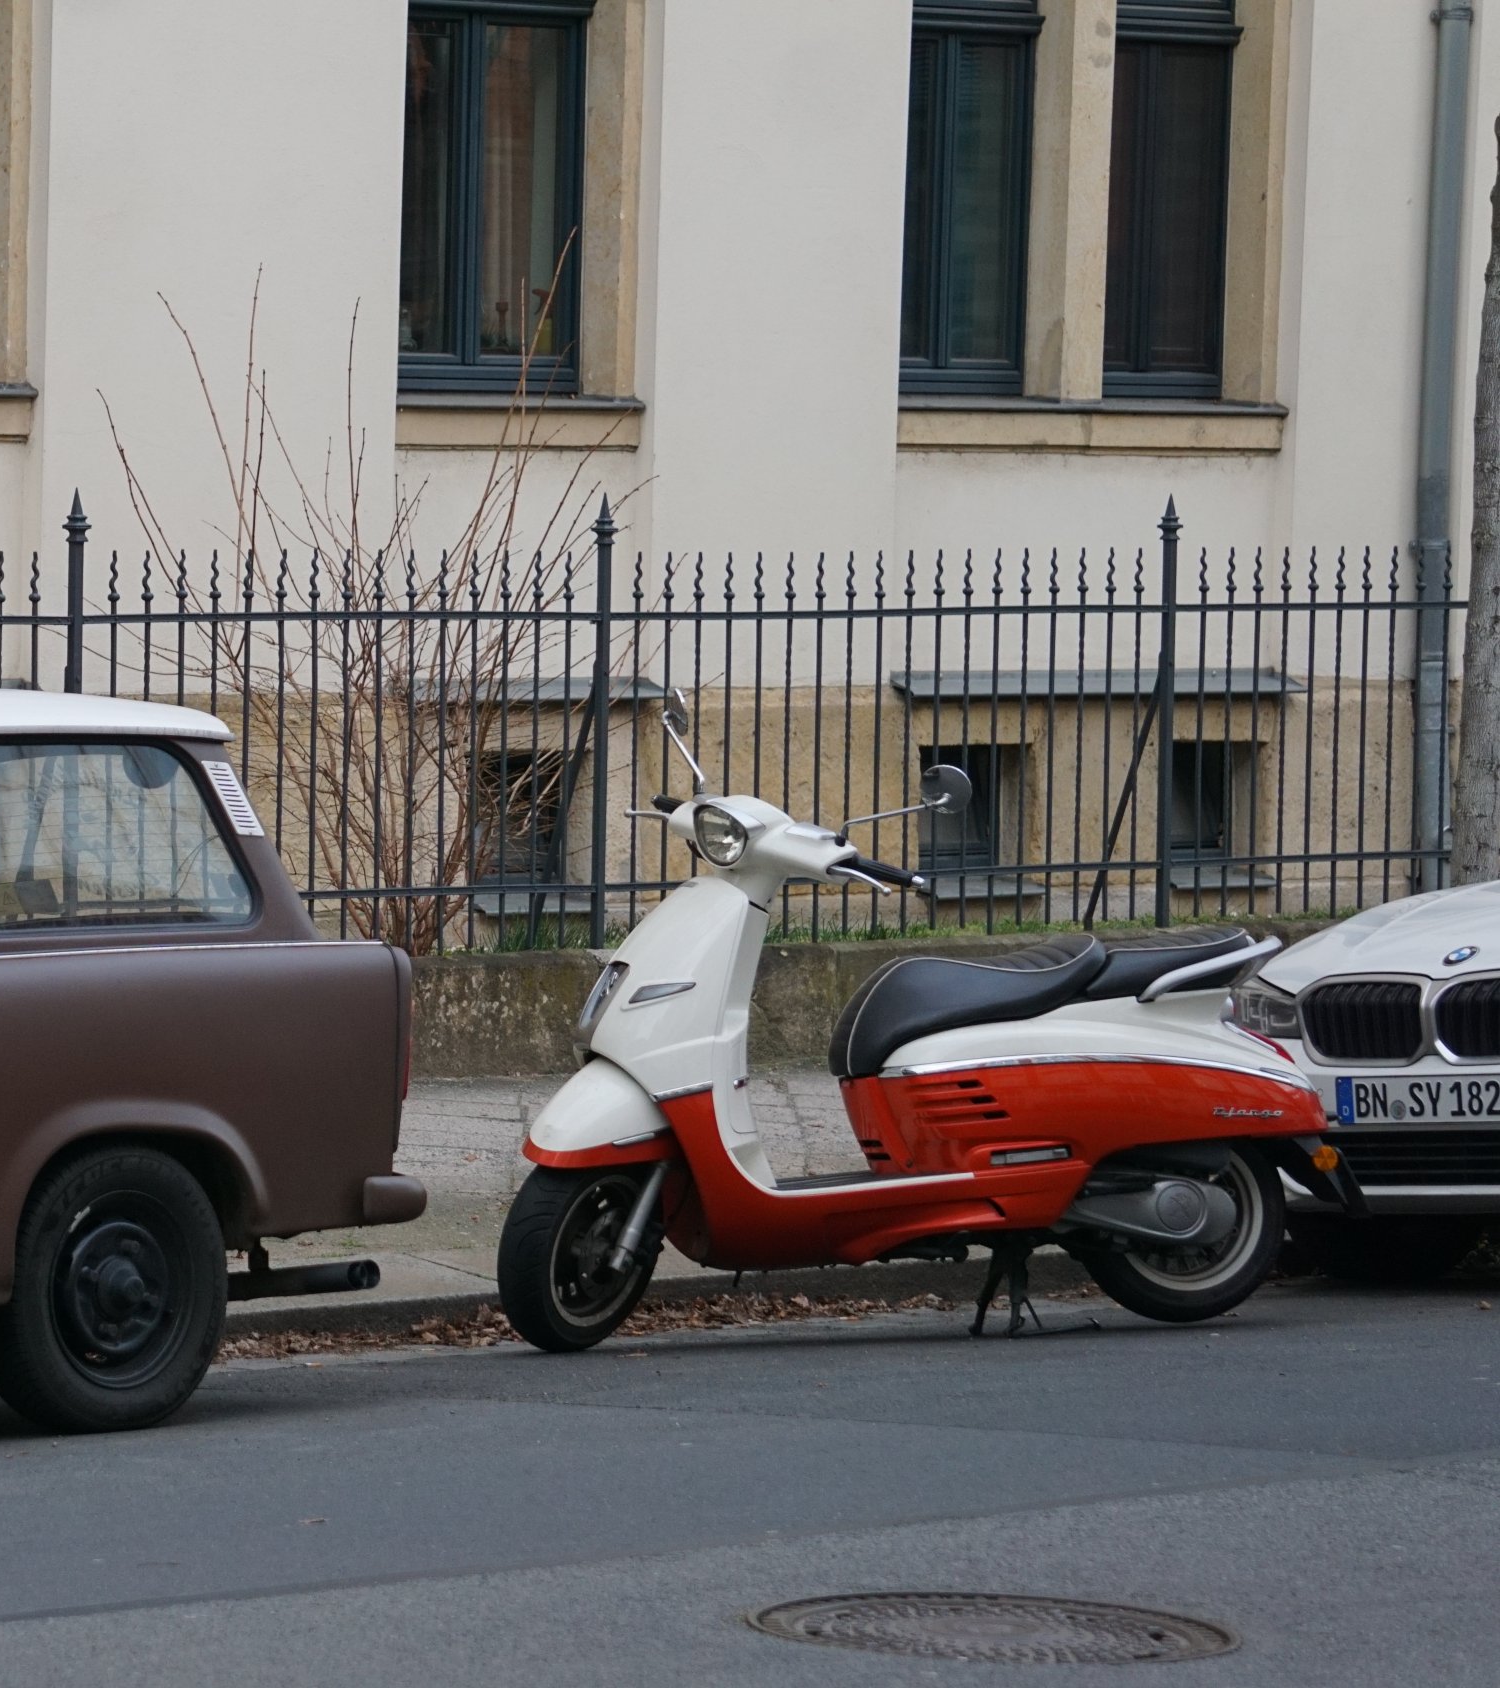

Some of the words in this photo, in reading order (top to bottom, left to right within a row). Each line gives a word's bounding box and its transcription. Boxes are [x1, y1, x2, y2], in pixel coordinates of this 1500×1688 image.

[1355, 1083, 1389, 1118] BN
[1409, 1081, 1442, 1117] SY
[1449, 1080, 1500, 1117] 182
[1212, 1106, 1284, 1119] Django
[1342, 1105, 1350, 1116] D
